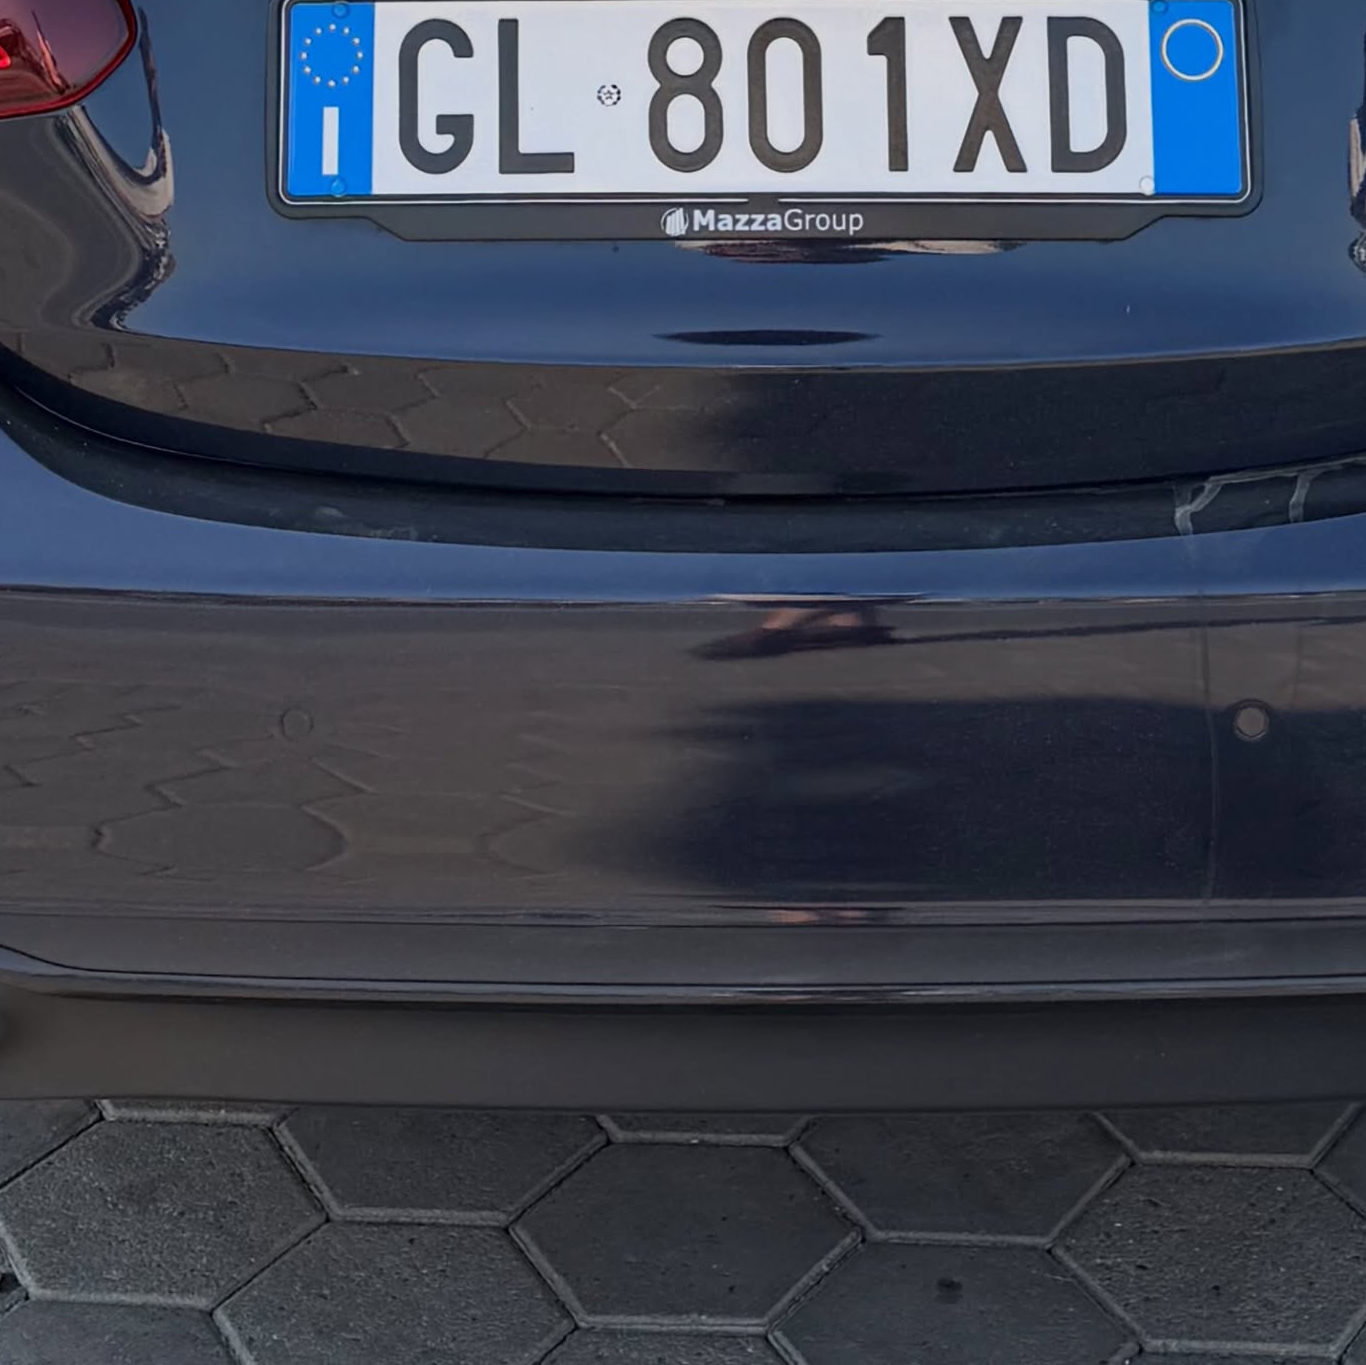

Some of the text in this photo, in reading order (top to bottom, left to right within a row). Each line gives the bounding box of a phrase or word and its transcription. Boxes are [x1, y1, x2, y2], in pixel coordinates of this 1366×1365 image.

[398, 15, 575, 176] GL
[645, 14, 1127, 174] 801XD
[692, 208, 864, 236] MazzaGroup
